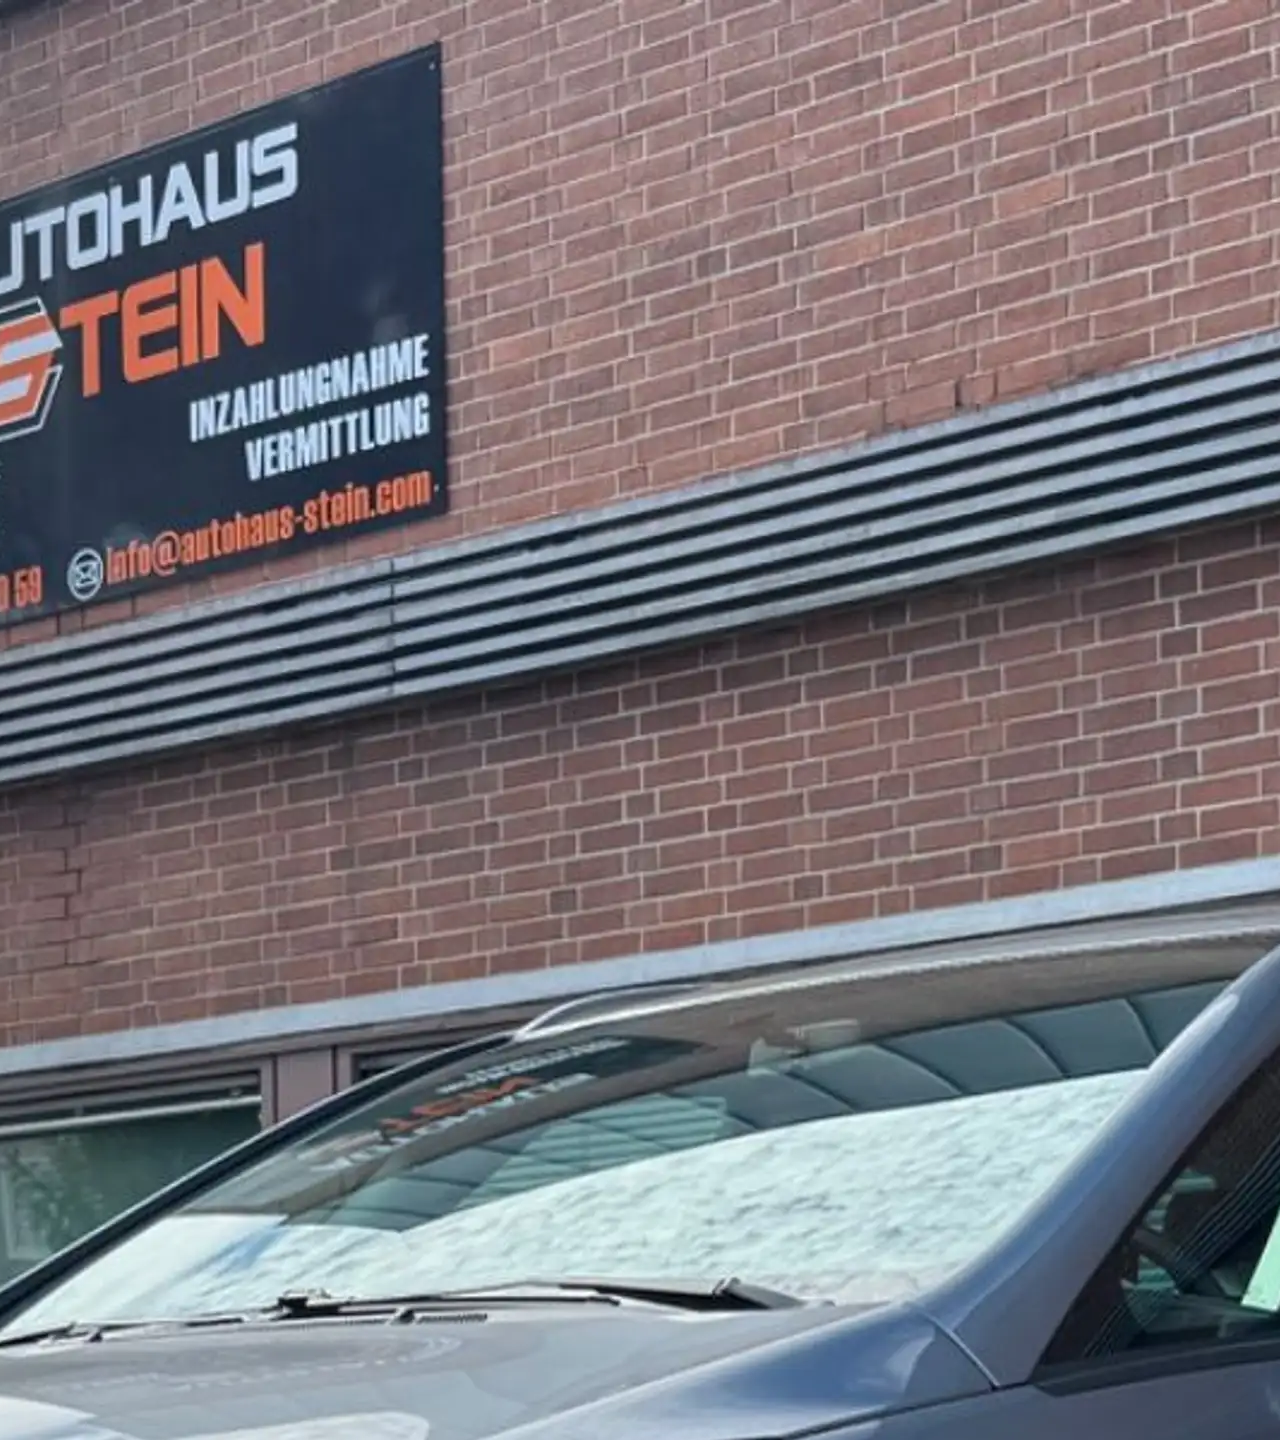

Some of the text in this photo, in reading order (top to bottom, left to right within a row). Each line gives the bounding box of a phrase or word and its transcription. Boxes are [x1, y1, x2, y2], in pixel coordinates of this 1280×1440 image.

[189, 333, 430, 443] INZAHLUNGNAHME
[244, 392, 430, 482] VERMITTLUNG
[106, 469, 432, 586] info@autohaus-stein.com
